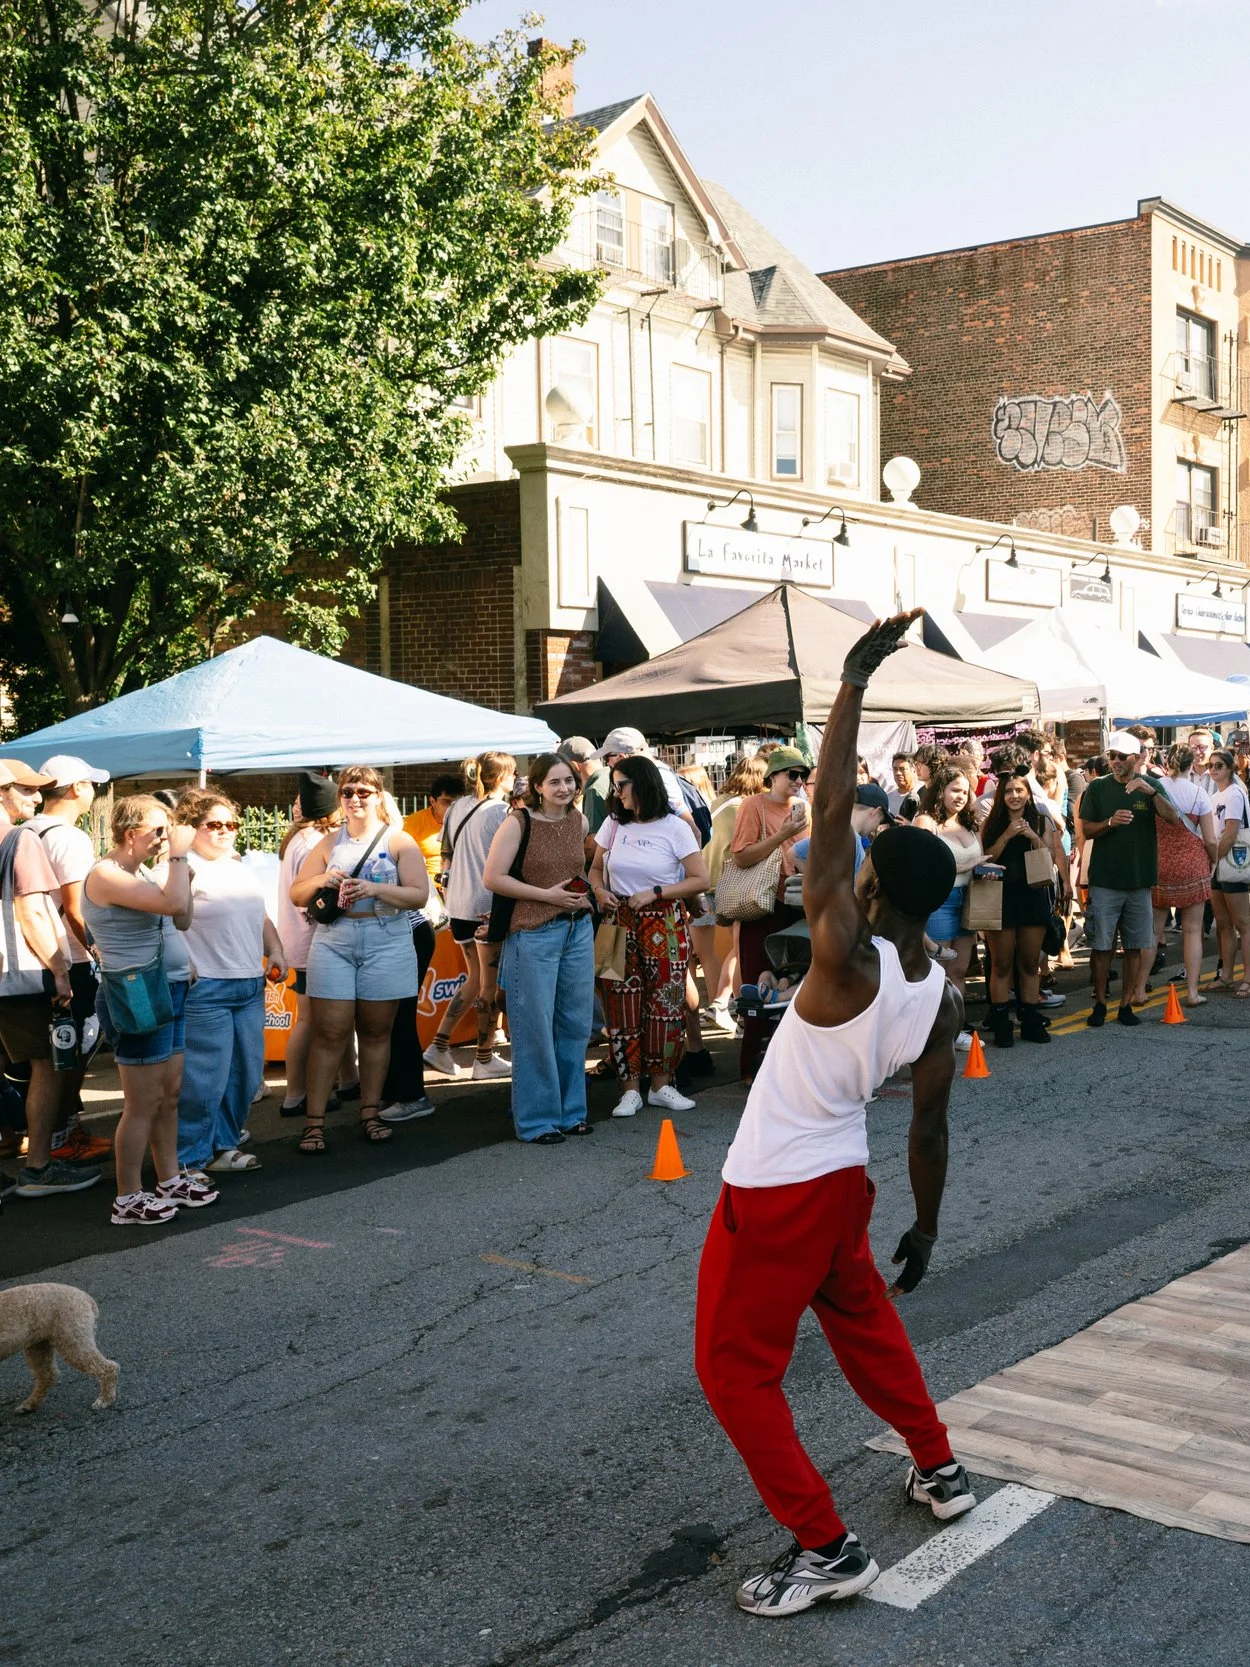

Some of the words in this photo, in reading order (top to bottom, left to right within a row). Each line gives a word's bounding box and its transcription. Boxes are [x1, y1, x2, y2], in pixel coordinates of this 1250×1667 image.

[698, 538, 714, 558] La
[781, 552, 823, 572] Market
[265, 1012, 291, 1028] chool
